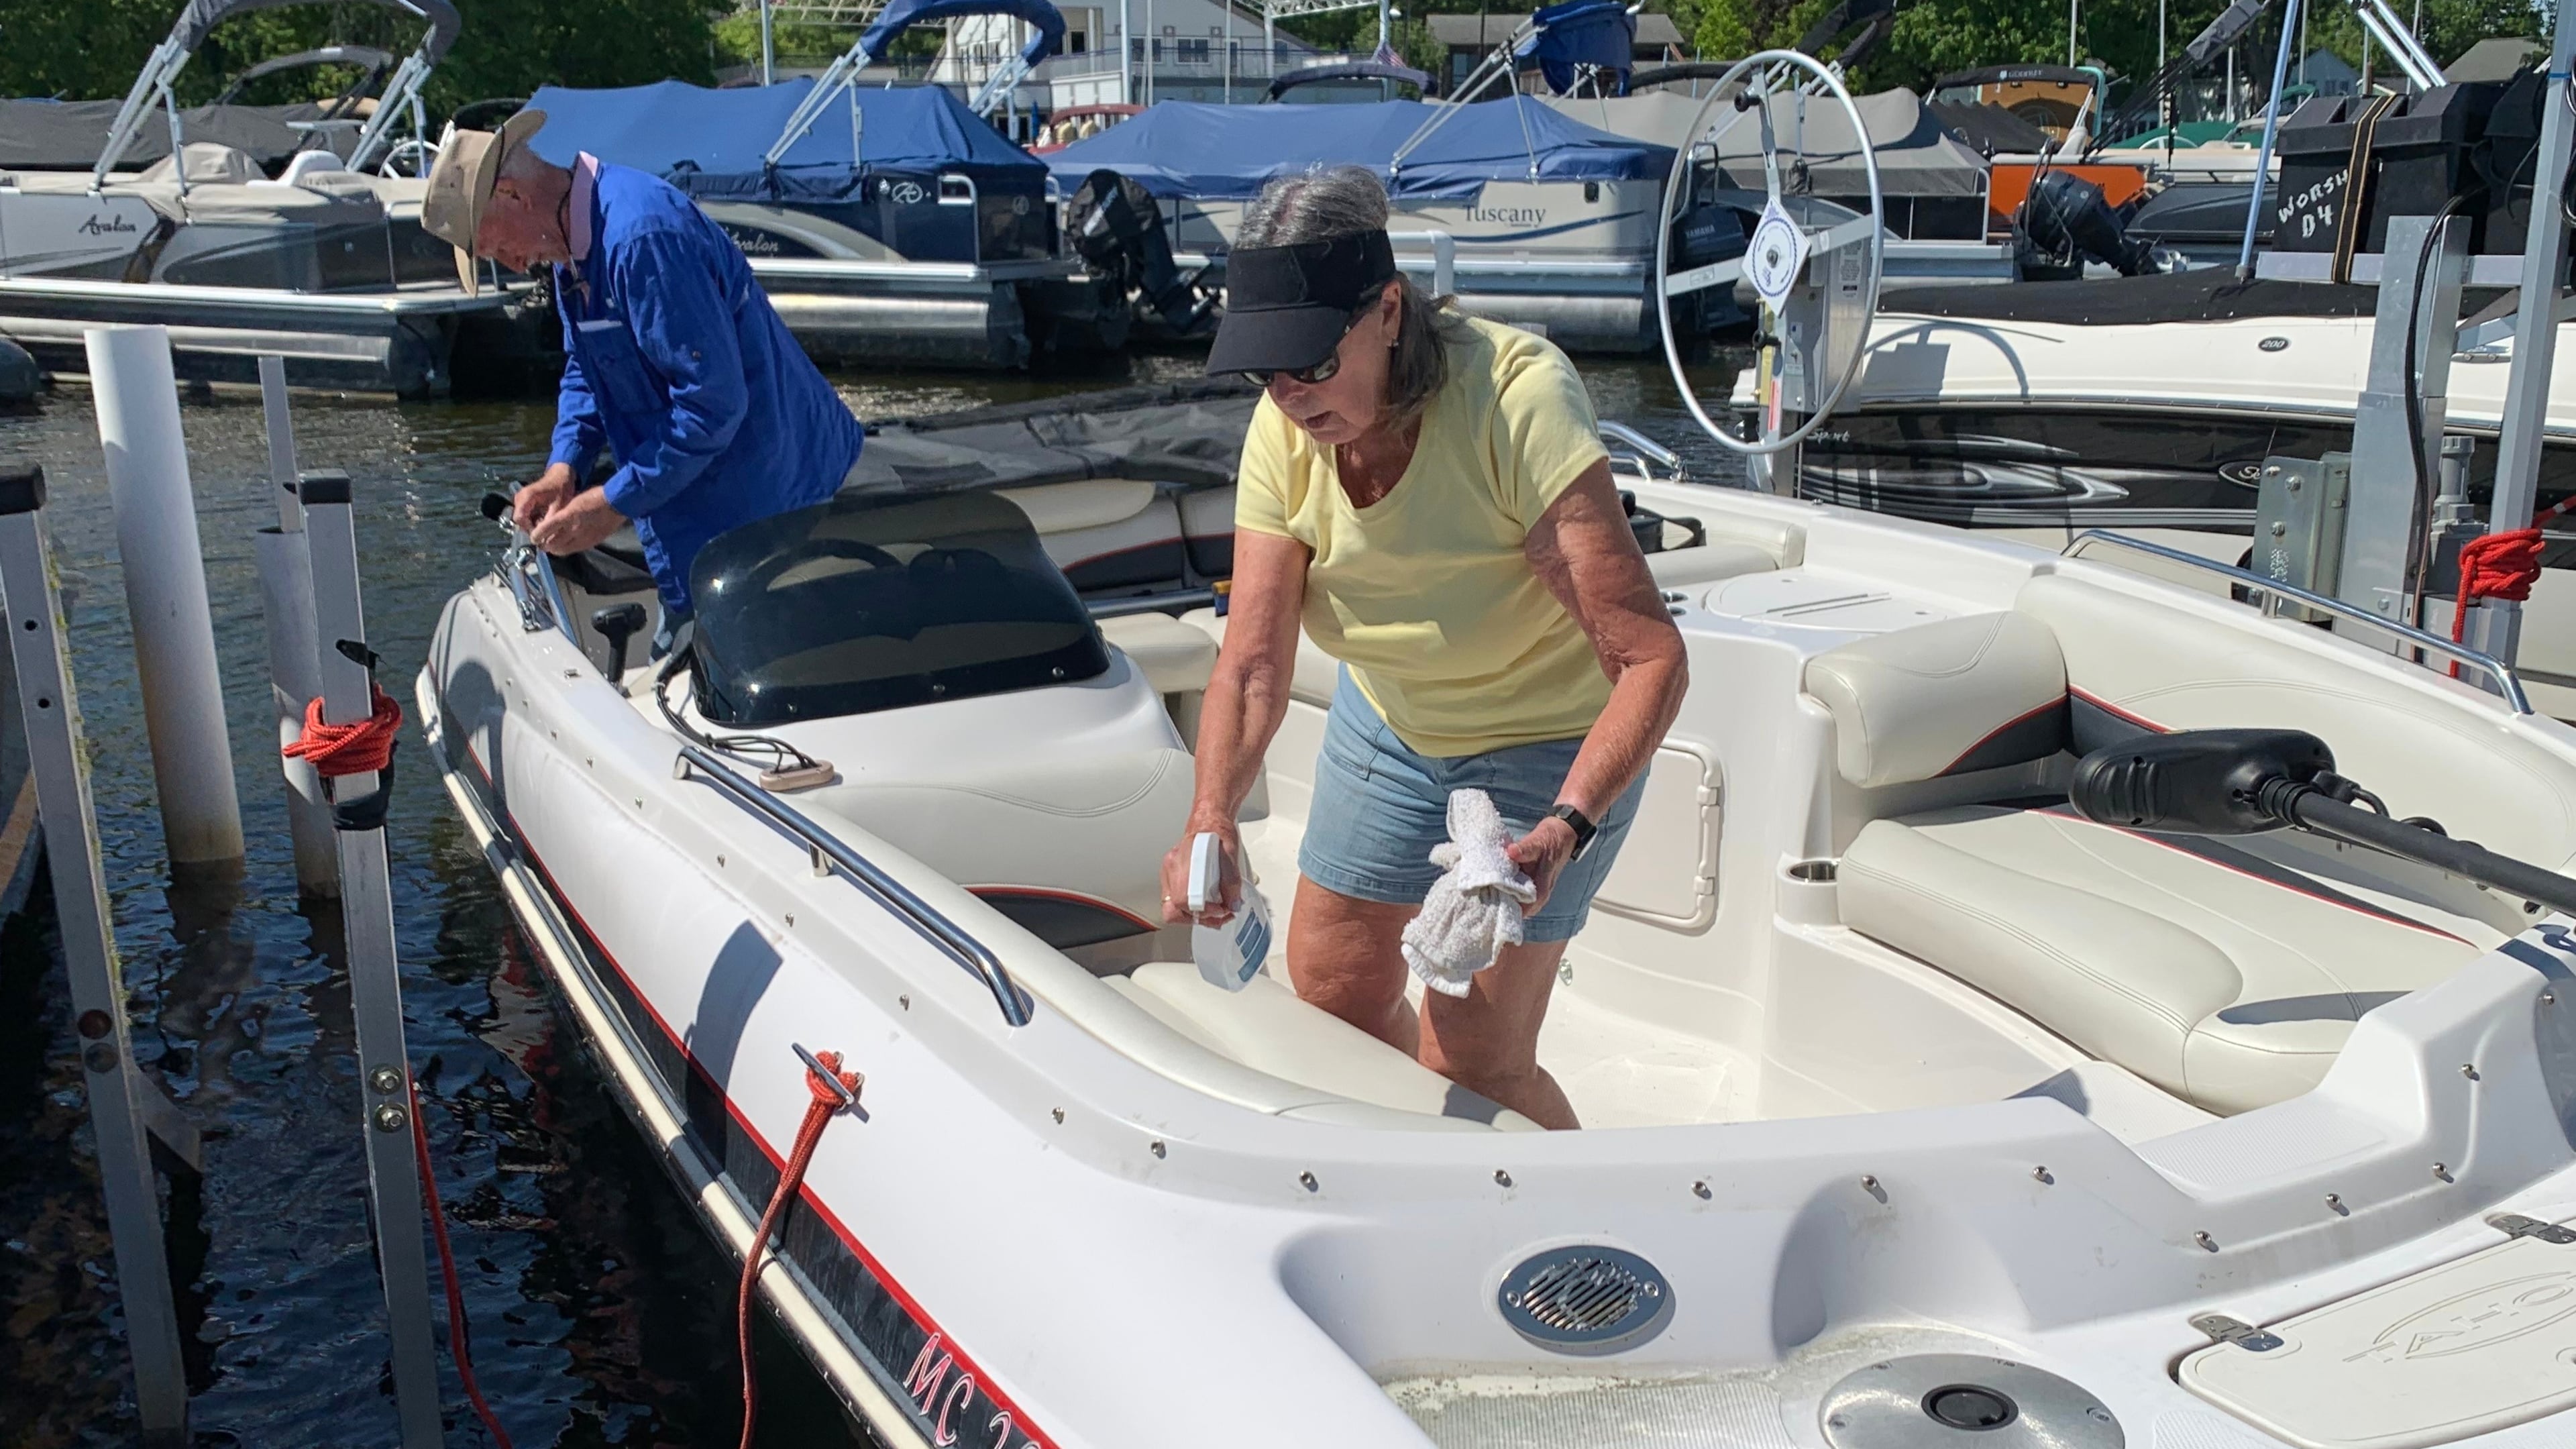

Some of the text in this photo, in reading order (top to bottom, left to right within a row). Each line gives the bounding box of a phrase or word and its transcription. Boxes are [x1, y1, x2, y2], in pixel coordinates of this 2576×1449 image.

[78, 214, 136, 235] Avalon
[1464, 205, 1546, 227] Tuscany
[1685, 224, 1715, 239] YAMAHA
[2261, 339, 2286, 348] 200
[2342, 1275, 2576, 1362] TAHO
[902, 1332, 975, 1448] MC
